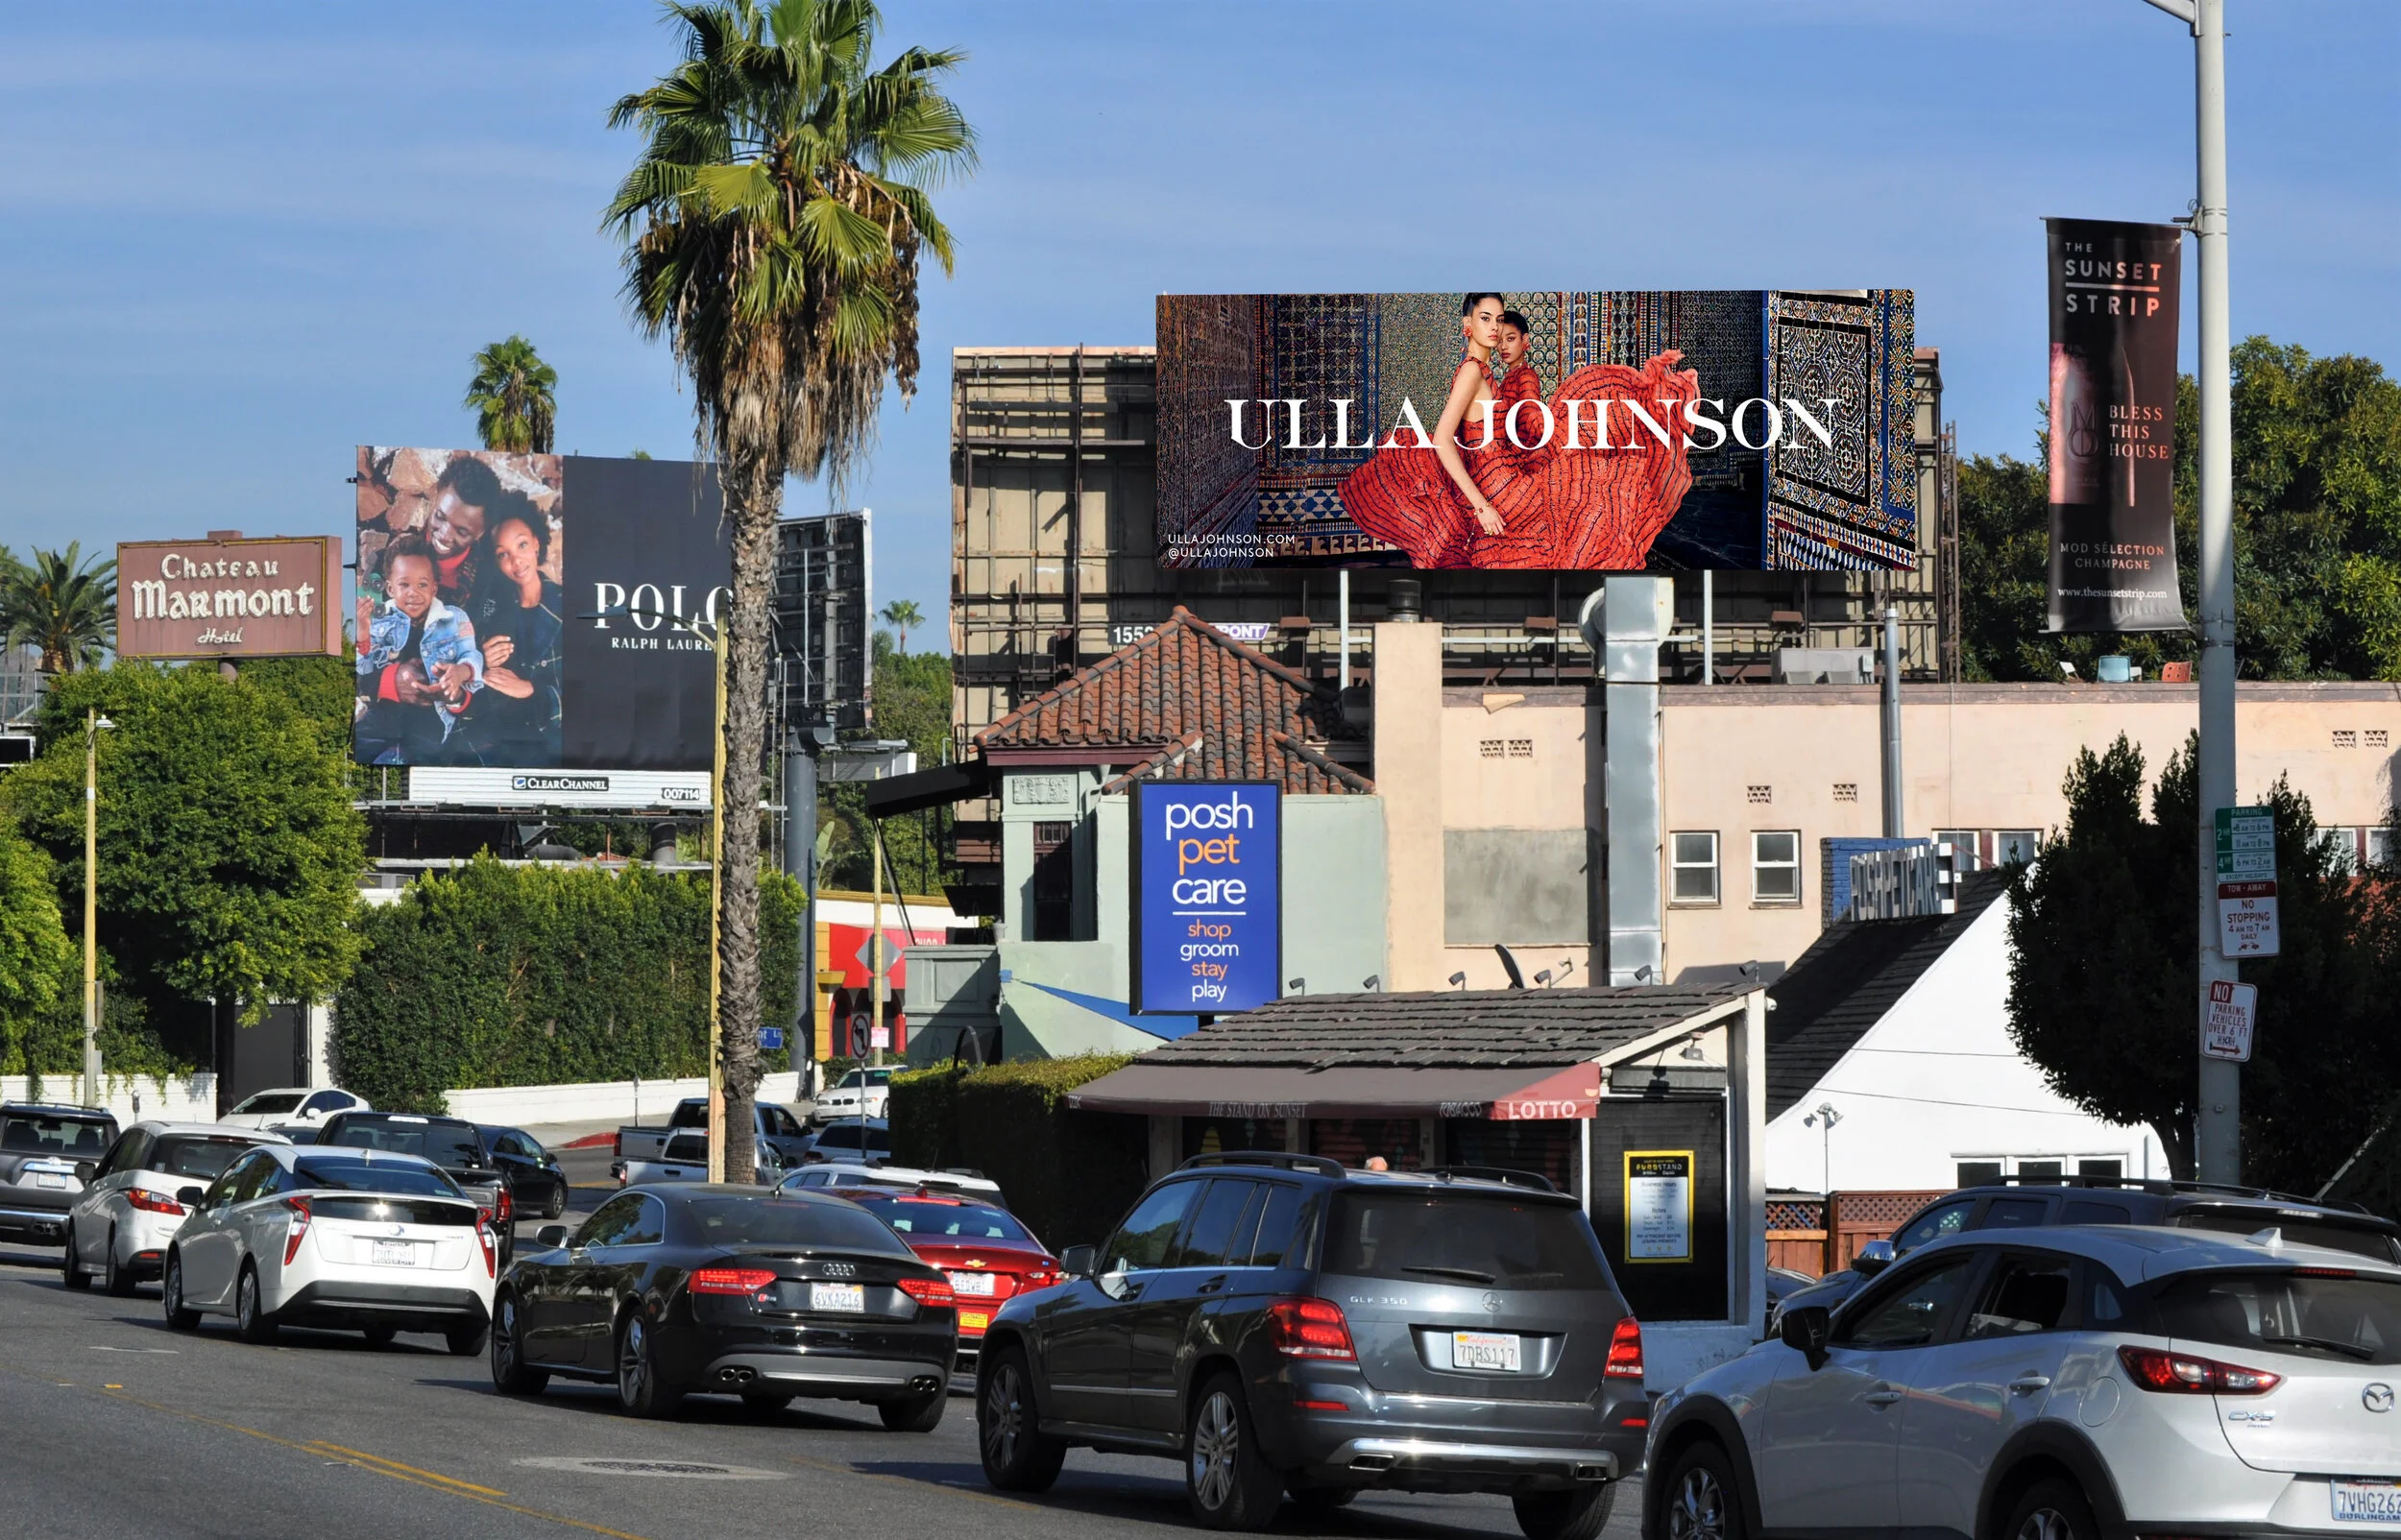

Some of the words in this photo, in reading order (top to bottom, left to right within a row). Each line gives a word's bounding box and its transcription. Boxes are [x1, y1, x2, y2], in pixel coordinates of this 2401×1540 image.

[2065, 242, 2093, 253] THE
[2065, 258, 2162, 281] SUNSET
[2065, 293, 2160, 317] STRIP
[2109, 403, 2164, 421] BLESS
[1224, 396, 1442, 450] ULLA
[1452, 397, 1844, 450] JOHNSON
[2109, 423, 2150, 440] THIS
[2109, 443, 2170, 460] HOUSE
[1168, 534, 1296, 544] ULLAJOHNSON.COM
[1168, 547, 1274, 559] @ULLAJOHNSON
[2060, 542, 2089, 554] MOD
[161, 553, 279, 580] Chateau
[2074, 558, 2151, 570] CHAMPAGNE
[2057, 587, 2168, 601] www.thesunsetstrip.com
[611, 637, 659, 650] RALPH
[667, 638, 714, 652] LAURE
[663, 788, 700, 800] 007114
[1165, 790, 1253, 841] posh
[2231, 807, 2263, 817] PARKING
[1178, 832, 1241, 876] pet
[1172, 878, 1247, 904] care
[2241, 899, 2255, 910] NO
[2227, 912, 2270, 925] STOPPING
[1187, 918, 1232, 942] shop
[1179, 943, 1240, 961] groom
[1191, 960, 1228, 981] stay
[1191, 978, 1227, 1002] play
[2214, 983, 2230, 1001] NO
[2215, 1002, 2245, 1017] PARKING
[2212, 1013, 2247, 1027] VEHICLES
[2208, 1023, 2226, 1035] OVER
[2229, 1026, 2235, 1036] 6
[2239, 1027, 2247, 1037] FT
[1208, 1101, 1225, 1118] THE
[1226, 1101, 1254, 1118] STAND
[1257, 1102, 1272, 1118] ON
[1273, 1102, 1308, 1119] SUNSET
[1440, 1101, 1483, 1118] TOBACCO
[1507, 1100, 1577, 1119] LOTTO
[1349, 1295, 1375, 1305] GLK
[1379, 1296, 1408, 1306] 350
[1459, 1345, 1516, 1365] 7DBS117
